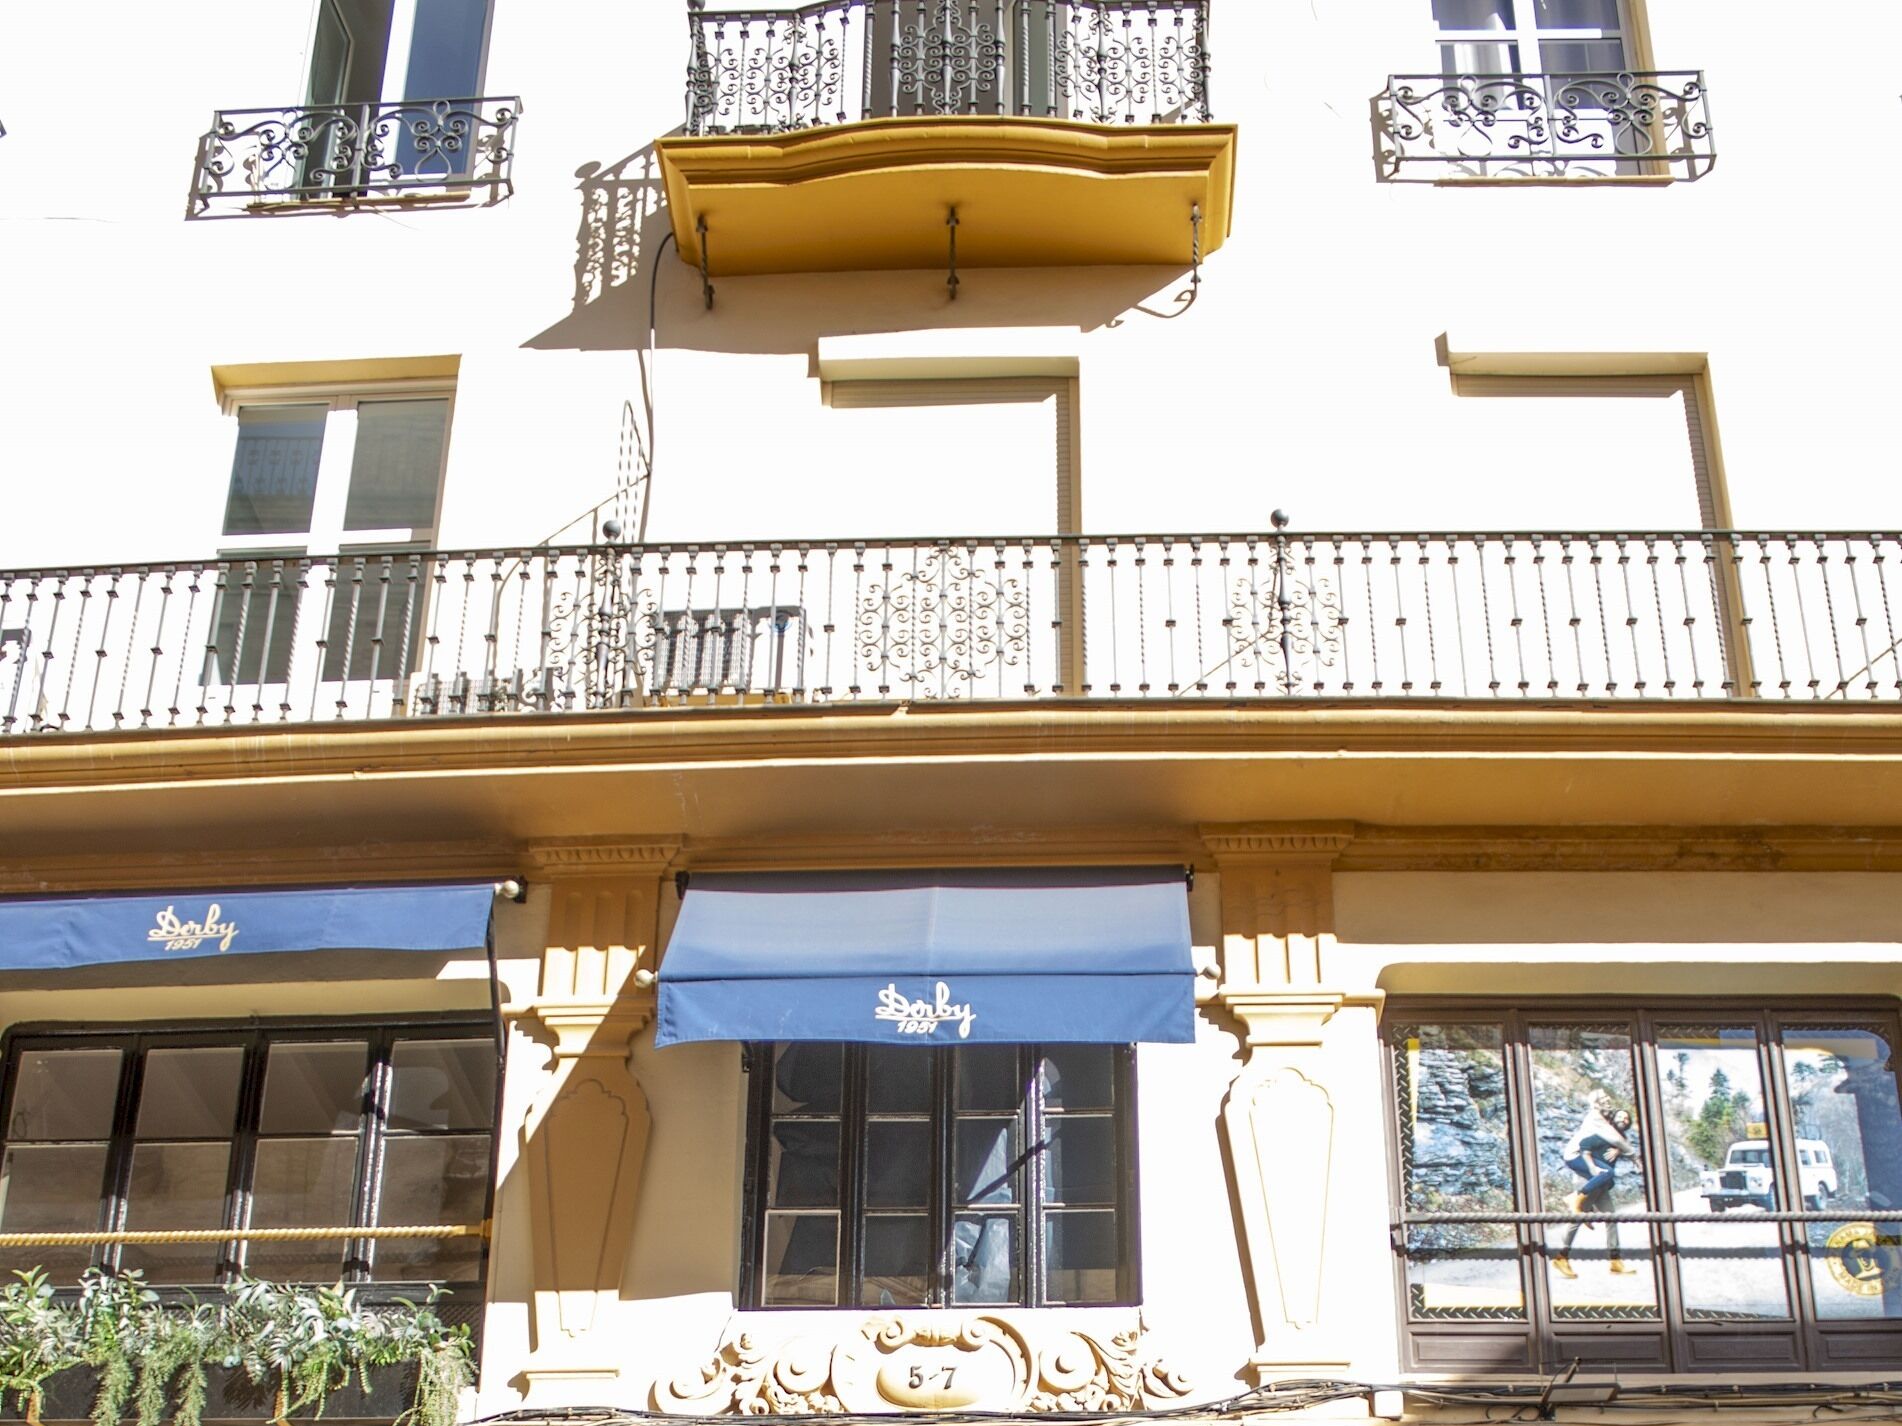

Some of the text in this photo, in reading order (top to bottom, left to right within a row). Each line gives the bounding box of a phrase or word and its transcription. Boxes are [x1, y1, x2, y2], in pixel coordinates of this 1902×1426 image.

[147, 903, 239, 951] Derby
[164, 938, 203, 951] 1951
[875, 981, 976, 1039] Derby
[897, 1020, 938, 1034] 1951
[908, 1364, 958, 1390] 5-7
